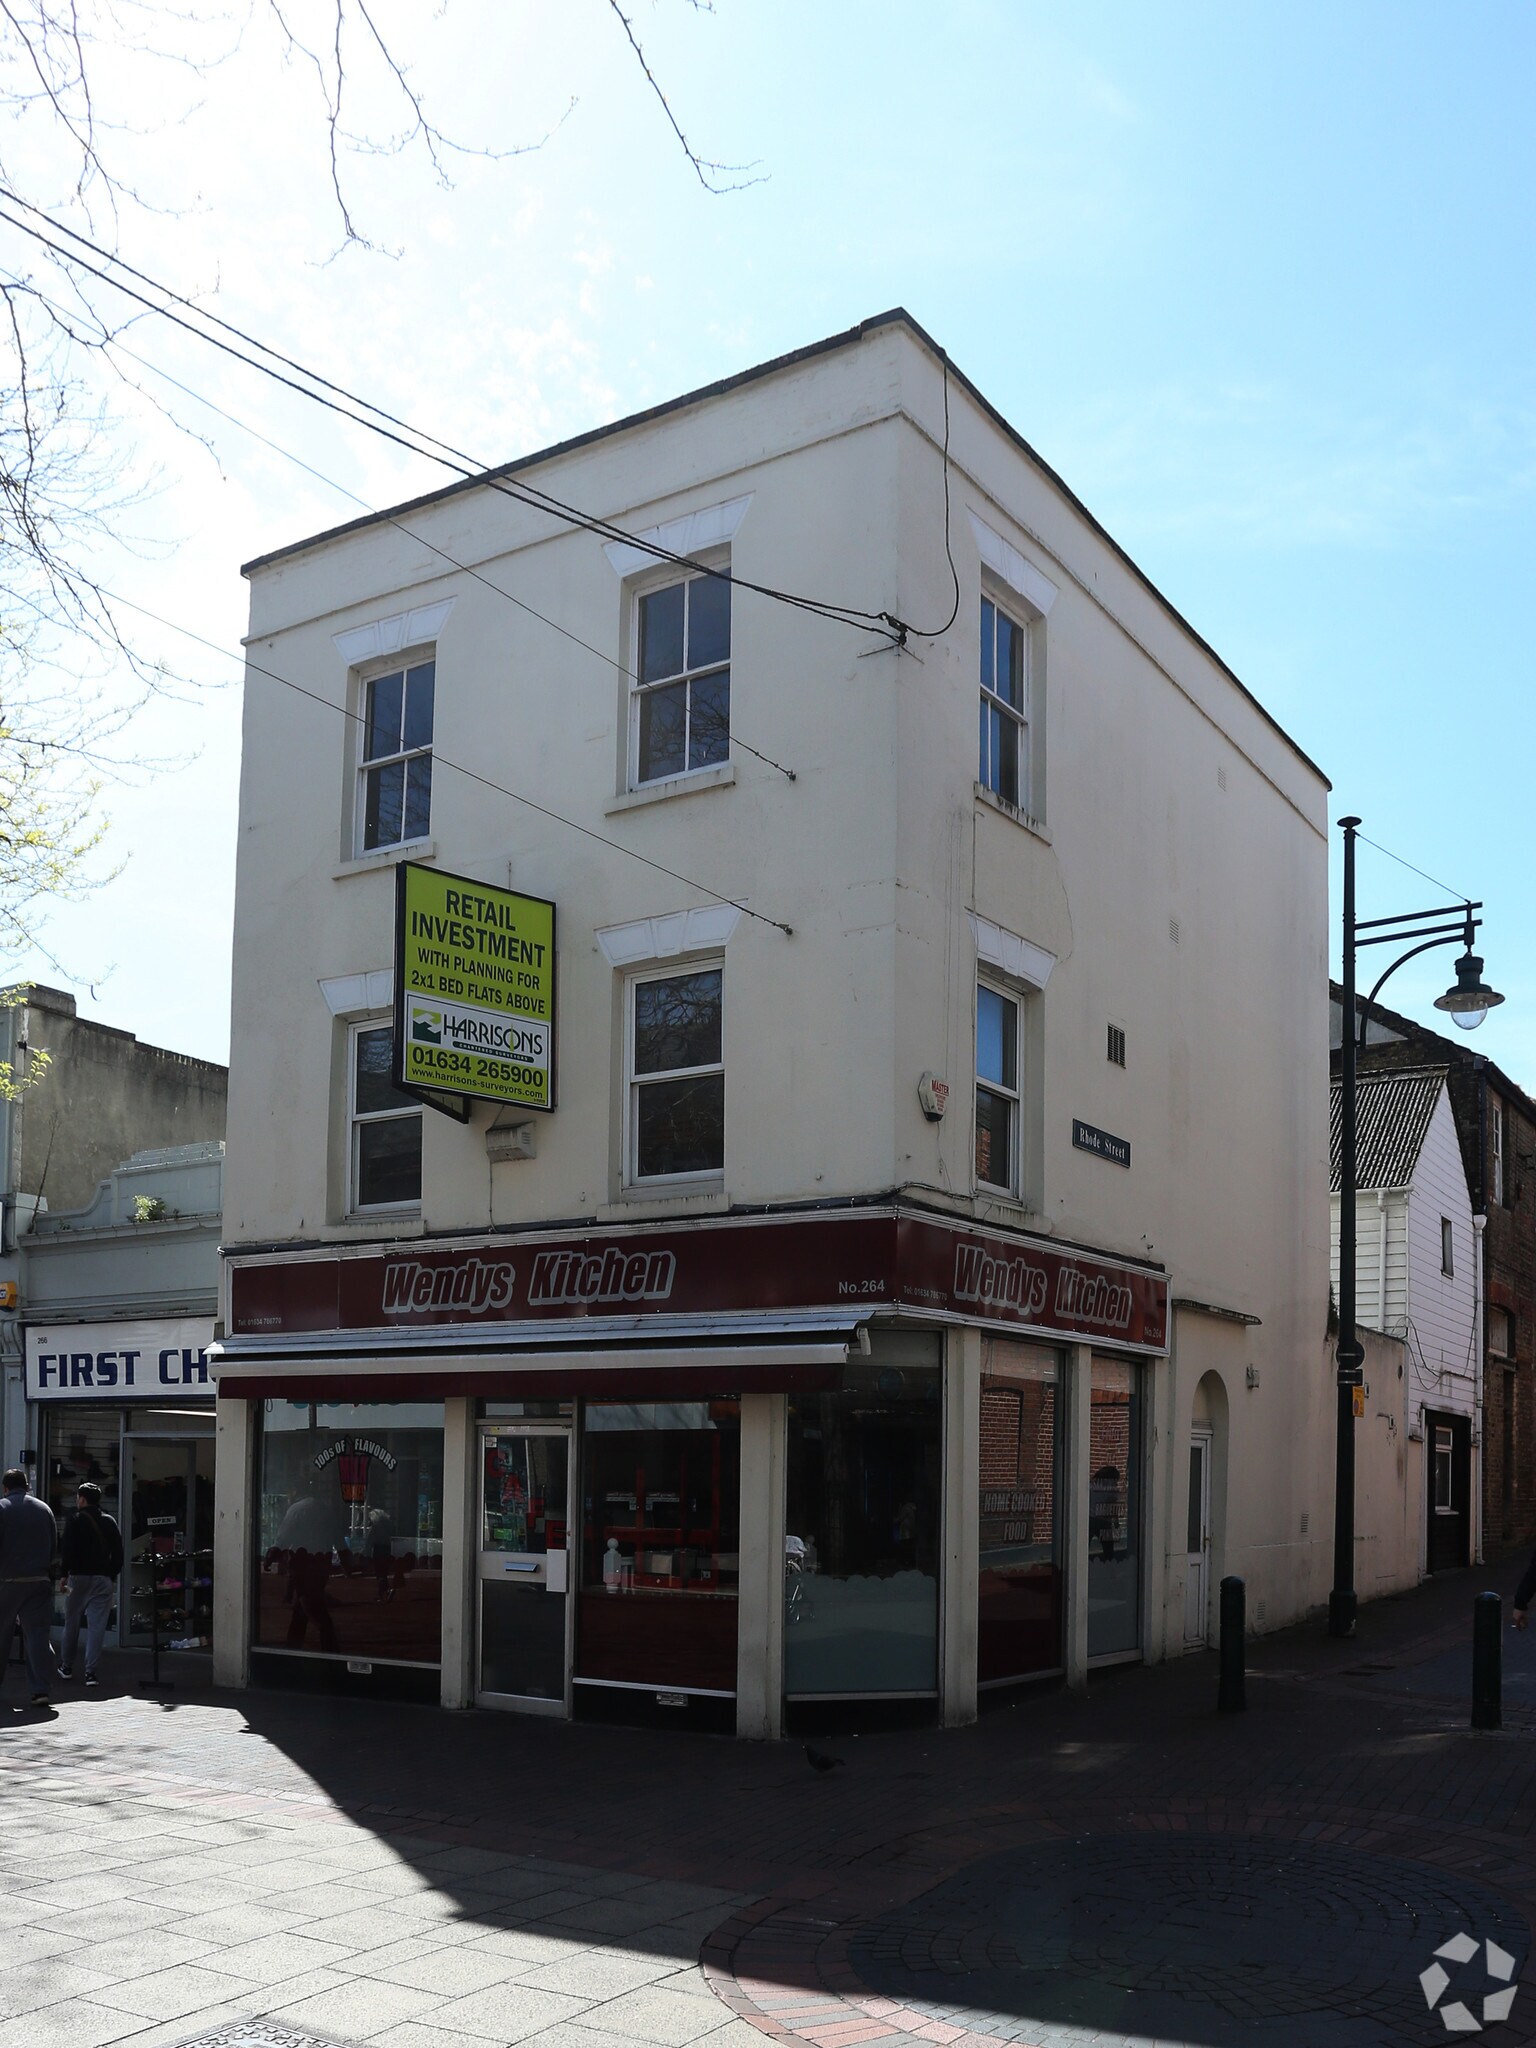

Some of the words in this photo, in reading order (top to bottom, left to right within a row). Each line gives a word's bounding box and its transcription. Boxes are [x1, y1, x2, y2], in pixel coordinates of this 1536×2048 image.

[446, 889, 516, 931] RETAIL
[412, 911, 546, 968] INVESTMENT
[417, 947, 450, 969] WITH
[453, 955, 514, 985] PLANNING
[517, 971, 540, 990] FOR
[411, 970, 435, 990] 2x1
[439, 976, 464, 995] BED
[467, 983, 503, 1004] FLATS
[506, 993, 545, 1014] ABOVE
[443, 1013, 543, 1055] HARRISONS
[411, 1068, 543, 1098] www.harrisons-surveyors.com
[412, 1046, 471, 1074] 01634
[477, 1058, 543, 1088] 265900
[1079, 1127, 1101, 1149] Rhode
[1104, 1138, 1125, 1159] Street
[382, 1257, 515, 1314] Wendys
[527, 1247, 676, 1306] Kitchen
[838, 1279, 885, 1295] No.264
[953, 1243, 1047, 1316] Wendys
[1054, 1266, 1133, 1329] Kitchen
[37, 1336, 48, 1344] 266
[38, 1351, 141, 1387] FIRST
[159, 1348, 216, 1385] CH
[334, 1440, 346, 1454] OF
[354, 1438, 397, 1470] FLAVOURS
[984, 1493, 1010, 1512] HOME
[1011, 1493, 1046, 1511] COOKED
[1004, 1522, 1027, 1542] FOOD
